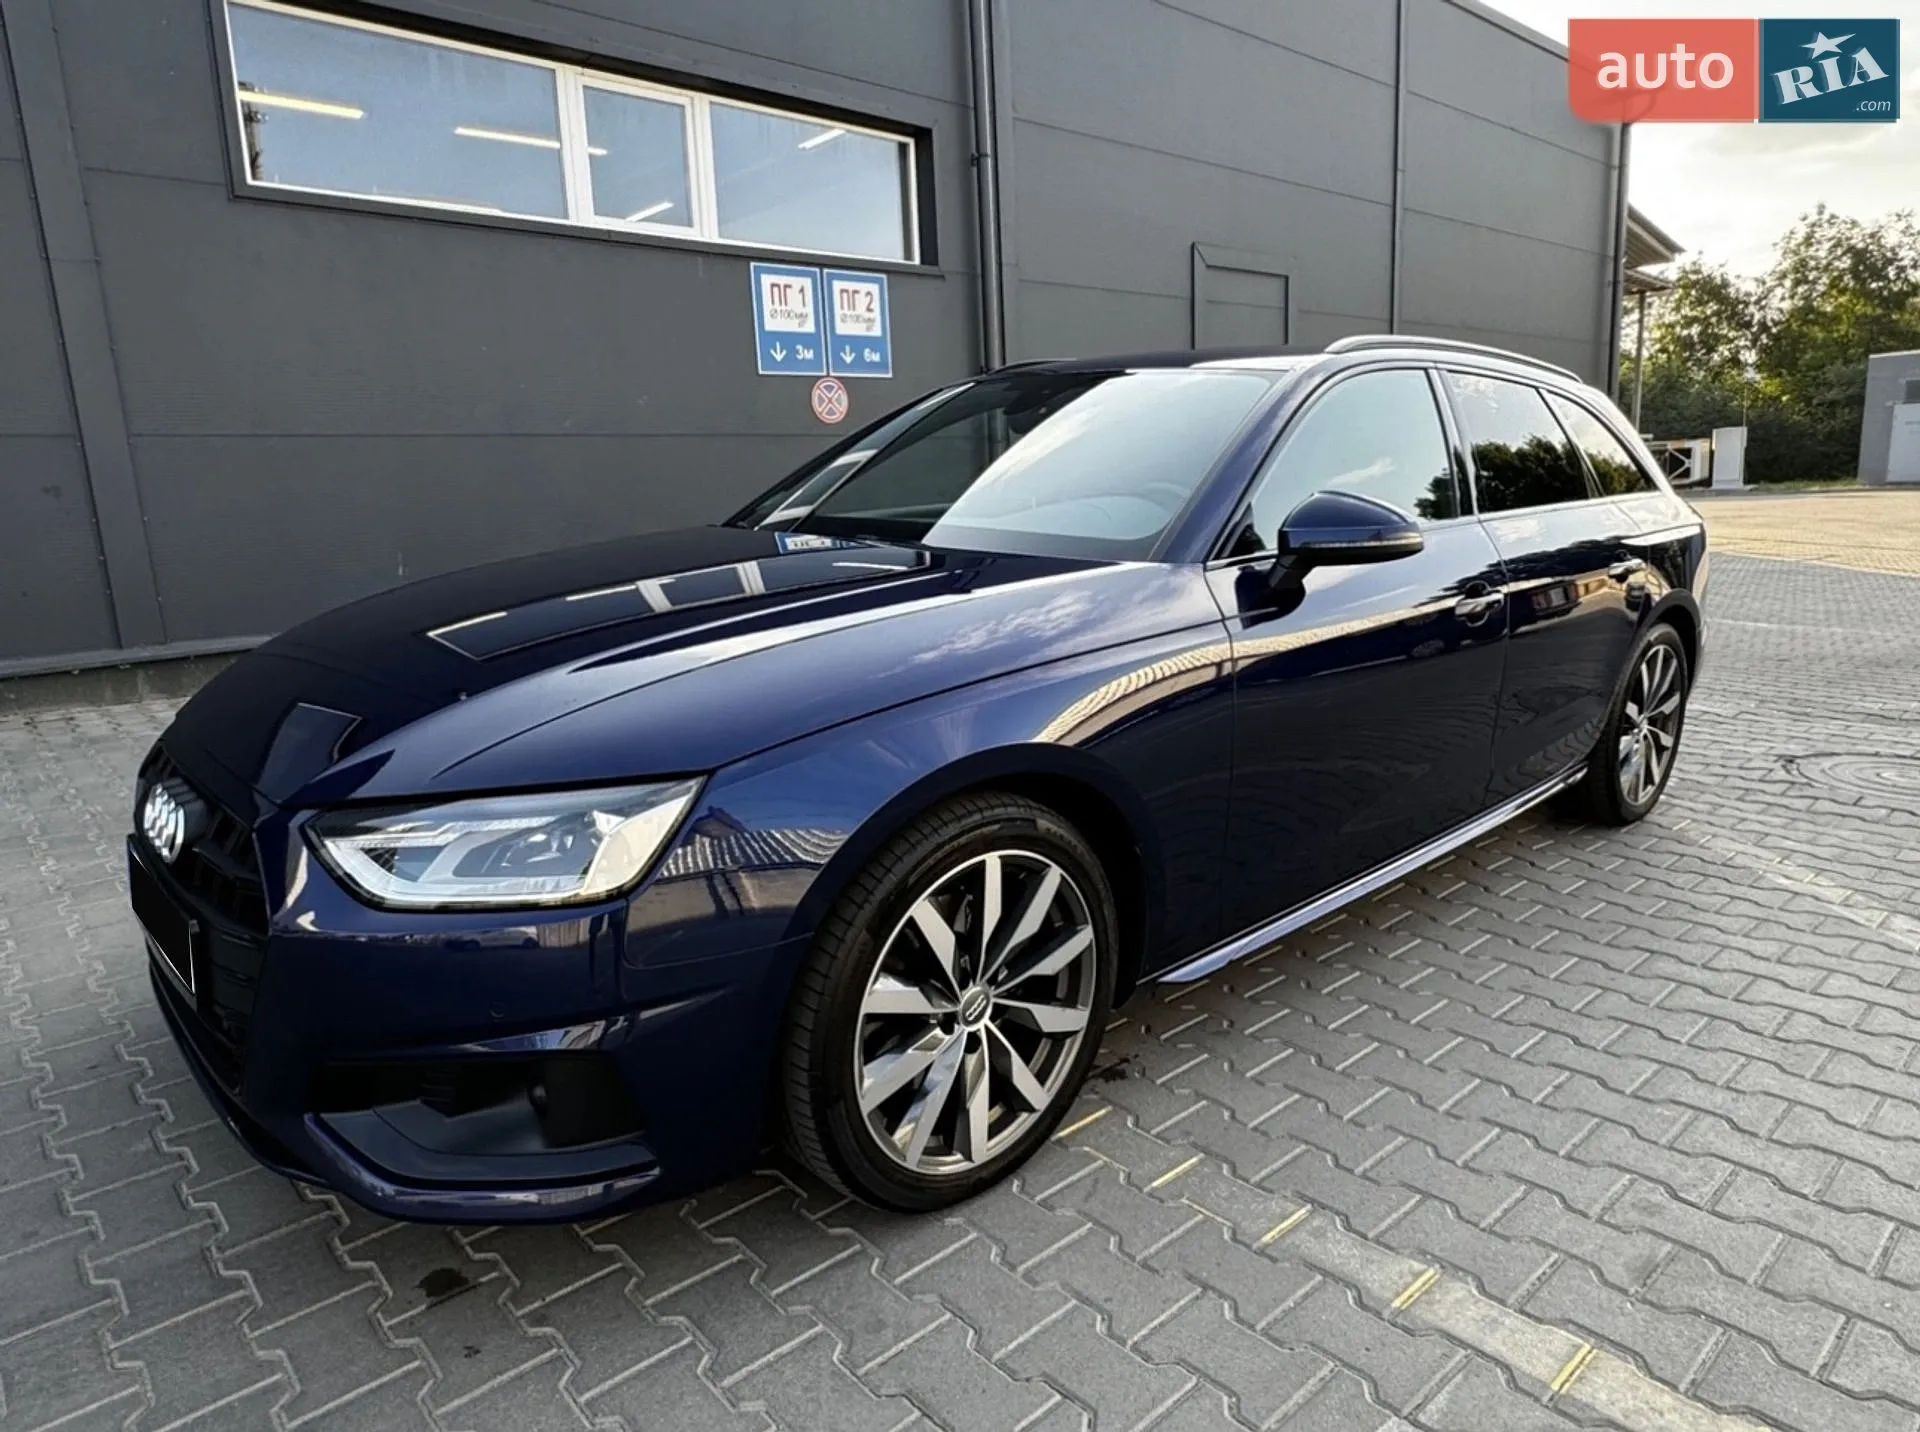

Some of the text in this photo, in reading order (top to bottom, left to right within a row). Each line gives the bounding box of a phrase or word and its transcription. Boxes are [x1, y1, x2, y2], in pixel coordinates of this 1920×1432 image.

[770, 283, 807, 308] ПГ 1
[840, 289, 874, 312] ПГ 2
[795, 344, 815, 361] 3м
